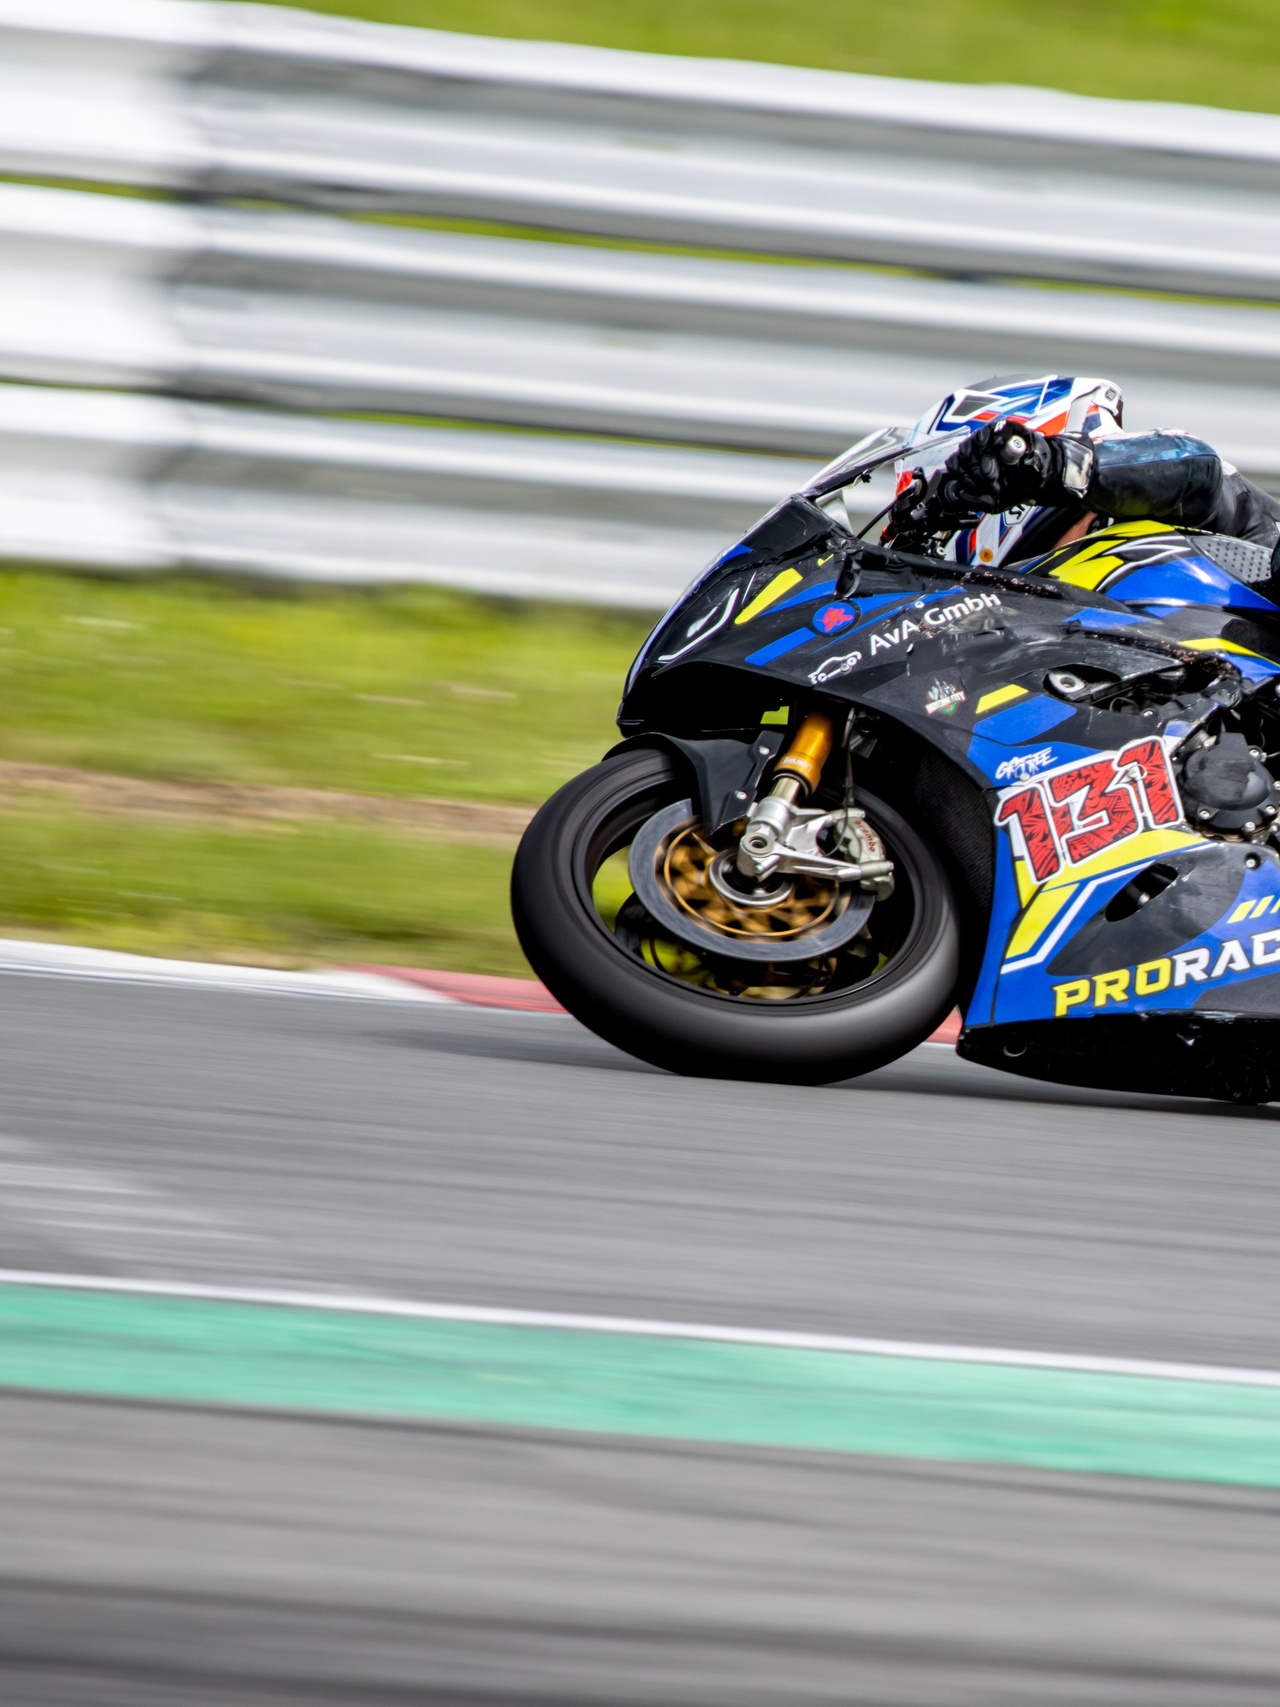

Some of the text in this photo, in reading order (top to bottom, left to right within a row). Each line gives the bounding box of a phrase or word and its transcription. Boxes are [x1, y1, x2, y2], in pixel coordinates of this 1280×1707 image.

[870, 593, 1001, 656] AvA GmbH
[994, 736, 1184, 885] 131
